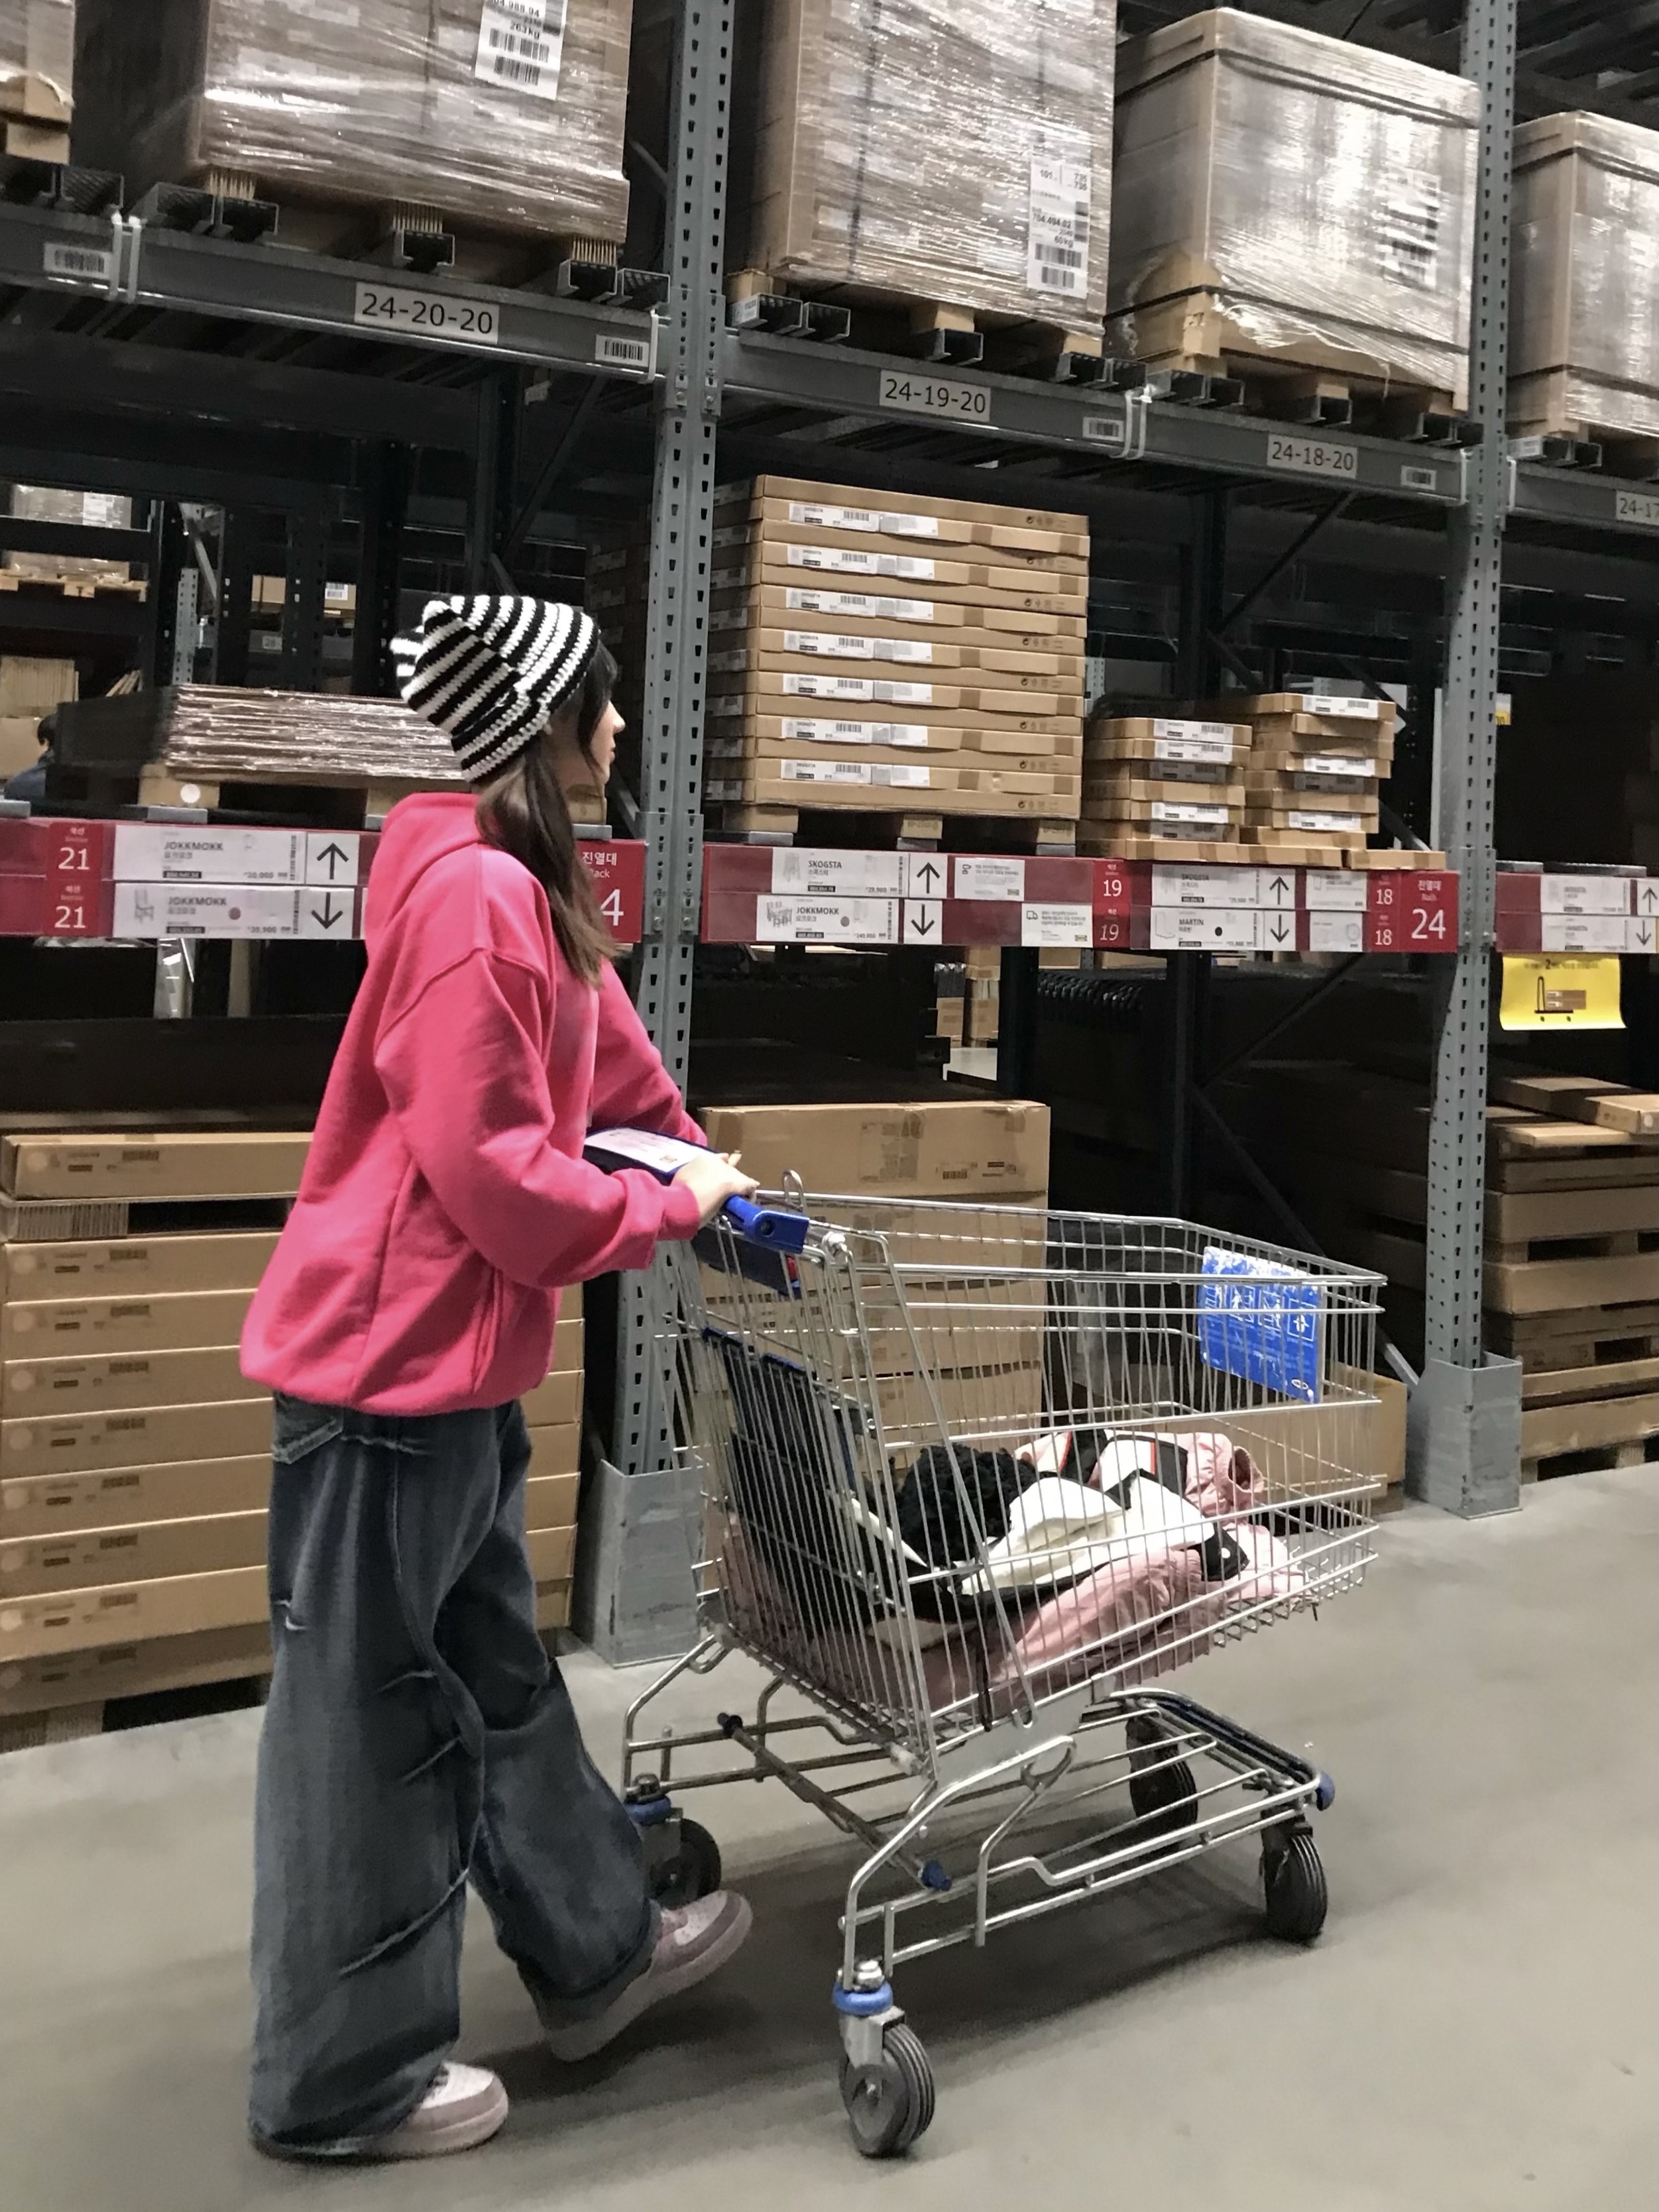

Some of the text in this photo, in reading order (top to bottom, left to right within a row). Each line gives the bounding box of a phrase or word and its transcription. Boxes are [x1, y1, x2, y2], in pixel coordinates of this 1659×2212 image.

[362, 293, 492, 334] 24-20-20
[886, 378, 986, 413] 24-19-20
[1273, 441, 1353, 470] 24-18-20
[164, 841, 223, 851] JOKKMOKK
[58, 847, 89, 870] 21
[583, 852, 618, 866] 진열대
[808, 860, 842, 869] SKOGSTA
[1103, 879, 1122, 897] 19
[168, 897, 227, 906] JOKKMOKK
[1376, 889, 1393, 905] 18
[54, 905, 86, 928] 21
[796, 907, 839, 916] JOKKMOKK
[1100, 924, 1119, 941] 19
[1411, 908, 1446, 940] 24
[1375, 929, 1392, 946] 18
